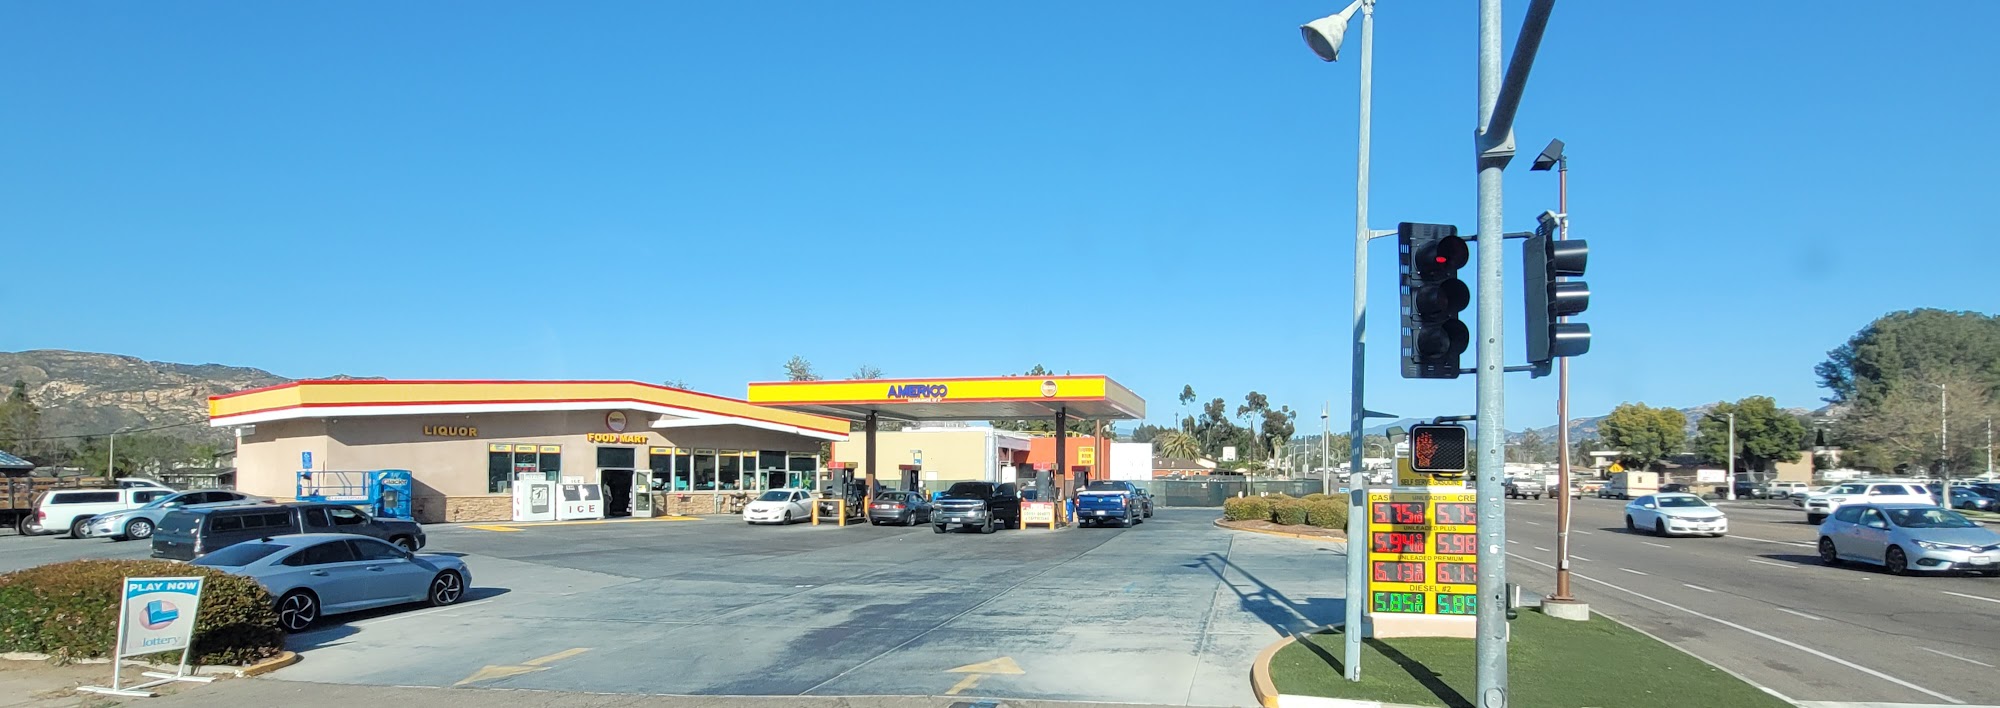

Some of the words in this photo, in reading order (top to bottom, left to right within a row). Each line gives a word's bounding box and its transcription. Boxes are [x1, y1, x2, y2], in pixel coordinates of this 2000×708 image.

[888, 384, 948, 398] AMERICO
[424, 425, 478, 437] LIQUOR
[587, 433, 617, 444] FOOD
[618, 434, 648, 445] MART
[1457, 494, 1476, 502] CRE
[569, 505, 596, 514] ICE
[129, 583, 164, 592] PLAY
[166, 582, 197, 591] NOW
[143, 636, 178, 647] lottery
